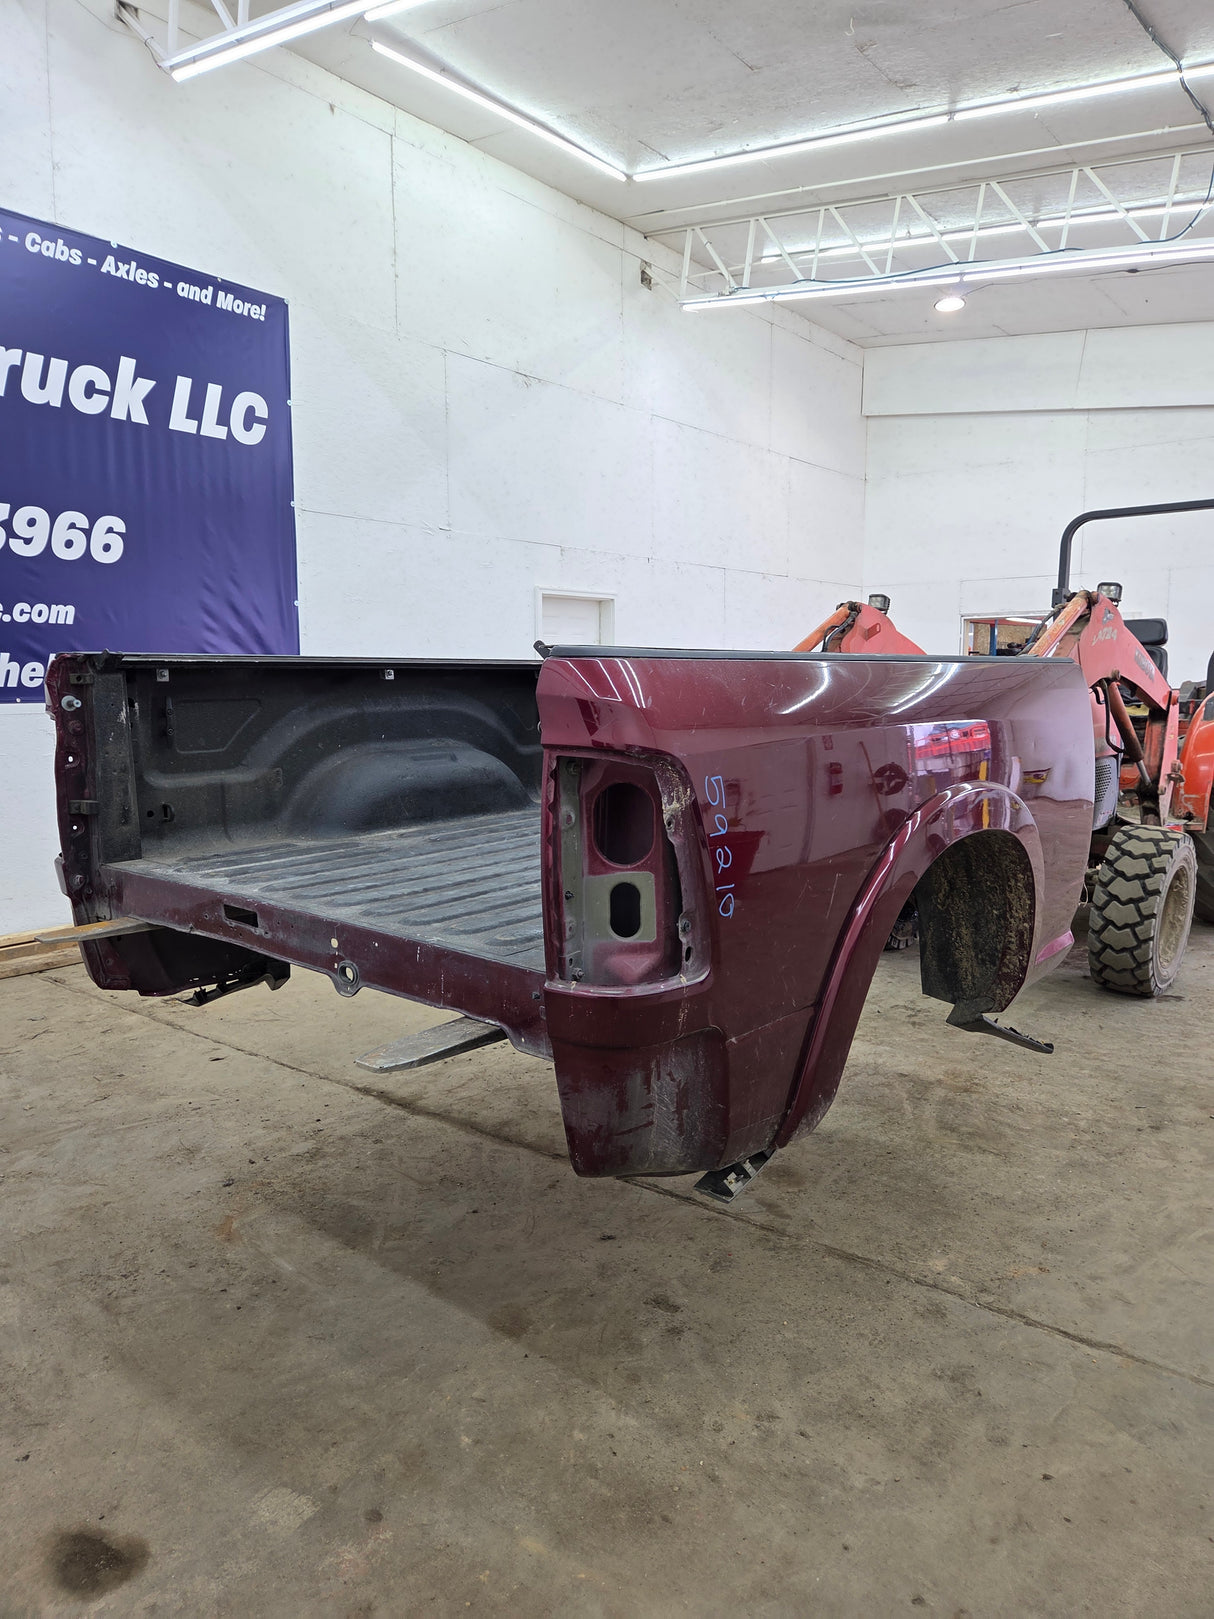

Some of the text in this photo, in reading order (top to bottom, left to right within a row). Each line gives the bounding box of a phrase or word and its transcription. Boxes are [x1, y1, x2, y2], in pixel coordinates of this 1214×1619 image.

[25, 232, 83, 265] Cabs
[101, 255, 160, 288] Axles
[176, 281, 214, 305] and
[216, 290, 267, 321] More!
[168, 375, 269, 446] LLC
[0, 502, 126, 564] 966
[0, 602, 76, 625] .com
[704, 775, 736, 919] 59210
